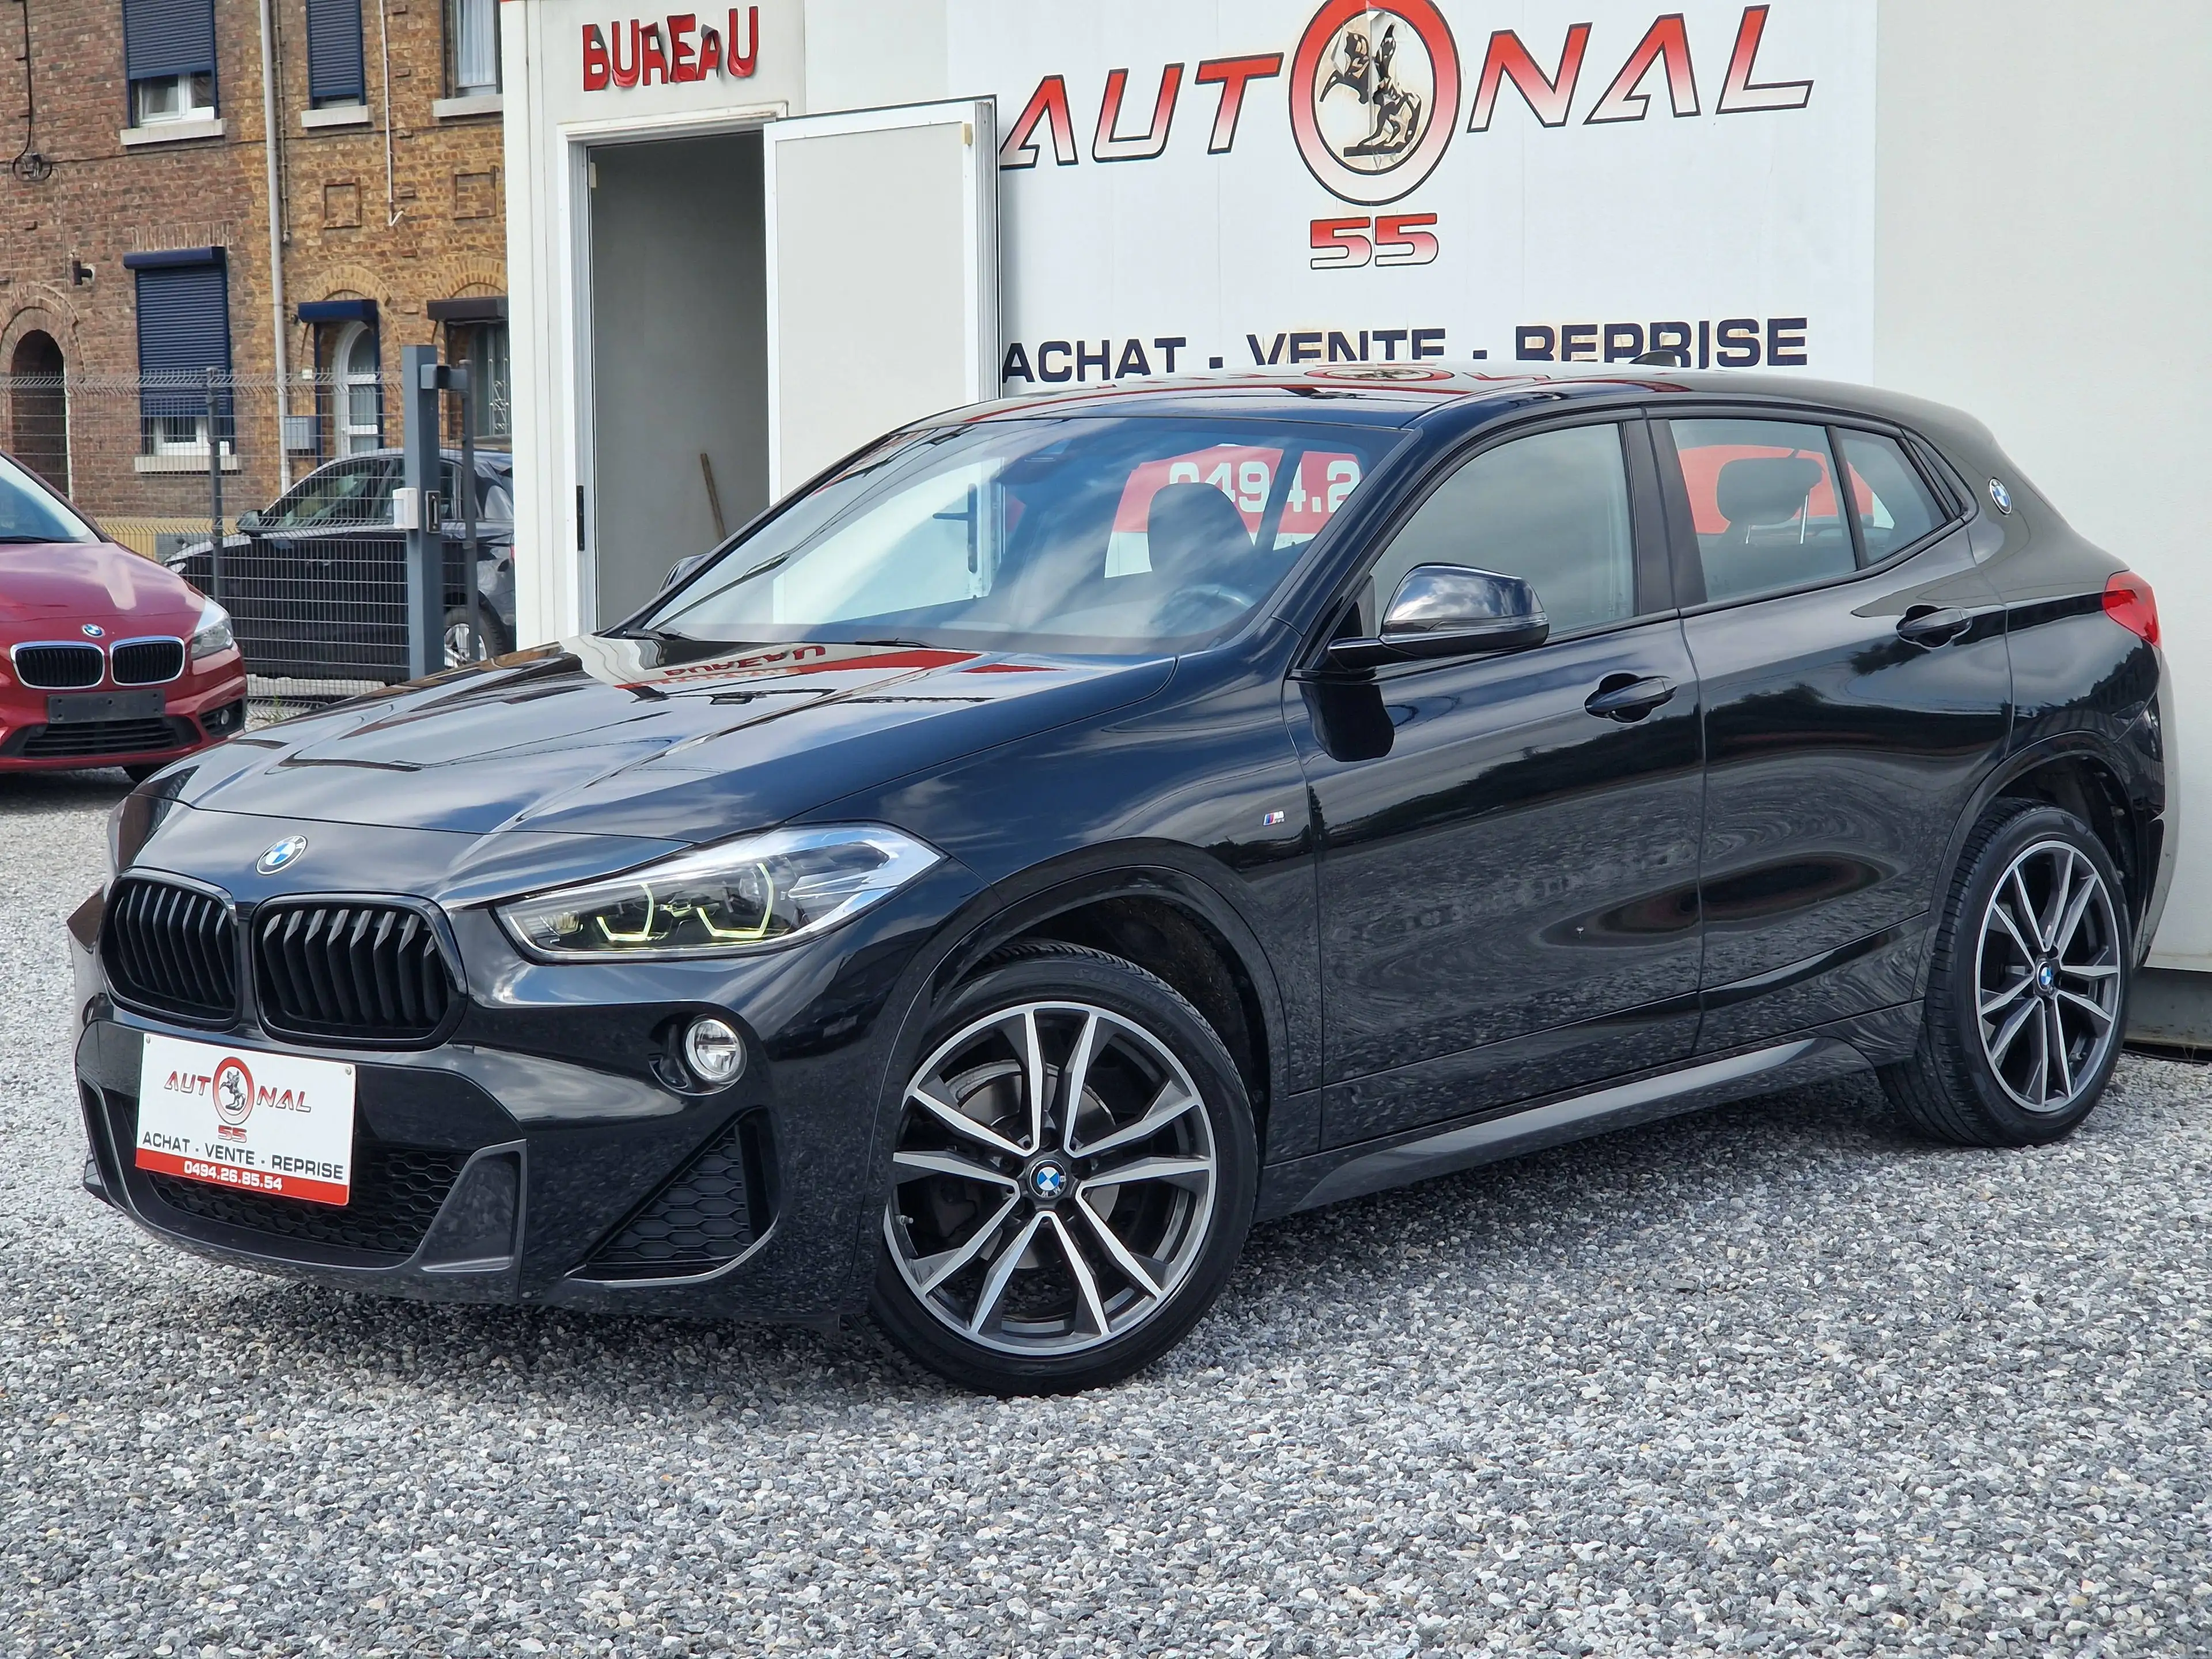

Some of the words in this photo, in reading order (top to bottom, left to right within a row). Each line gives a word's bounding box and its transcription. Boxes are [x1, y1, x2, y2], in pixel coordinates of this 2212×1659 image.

[583, 6, 759, 91] BUREAU
[1310, 213, 1439, 270] 55
[1002, 336, 1187, 383] ACHAT
[1246, 328, 1445, 365] VENTE
[1516, 317, 1808, 369] REPRISE
[164, 1056, 311, 1124] AUTONAL
[142, 1131, 191, 1153] ACHAT
[204, 1142, 255, 1165] VENTE
[271, 1154, 344, 1180] REPRISE
[218, 1124, 247, 1143] 55
[184, 1160, 283, 1191] 0494.26.85.54
